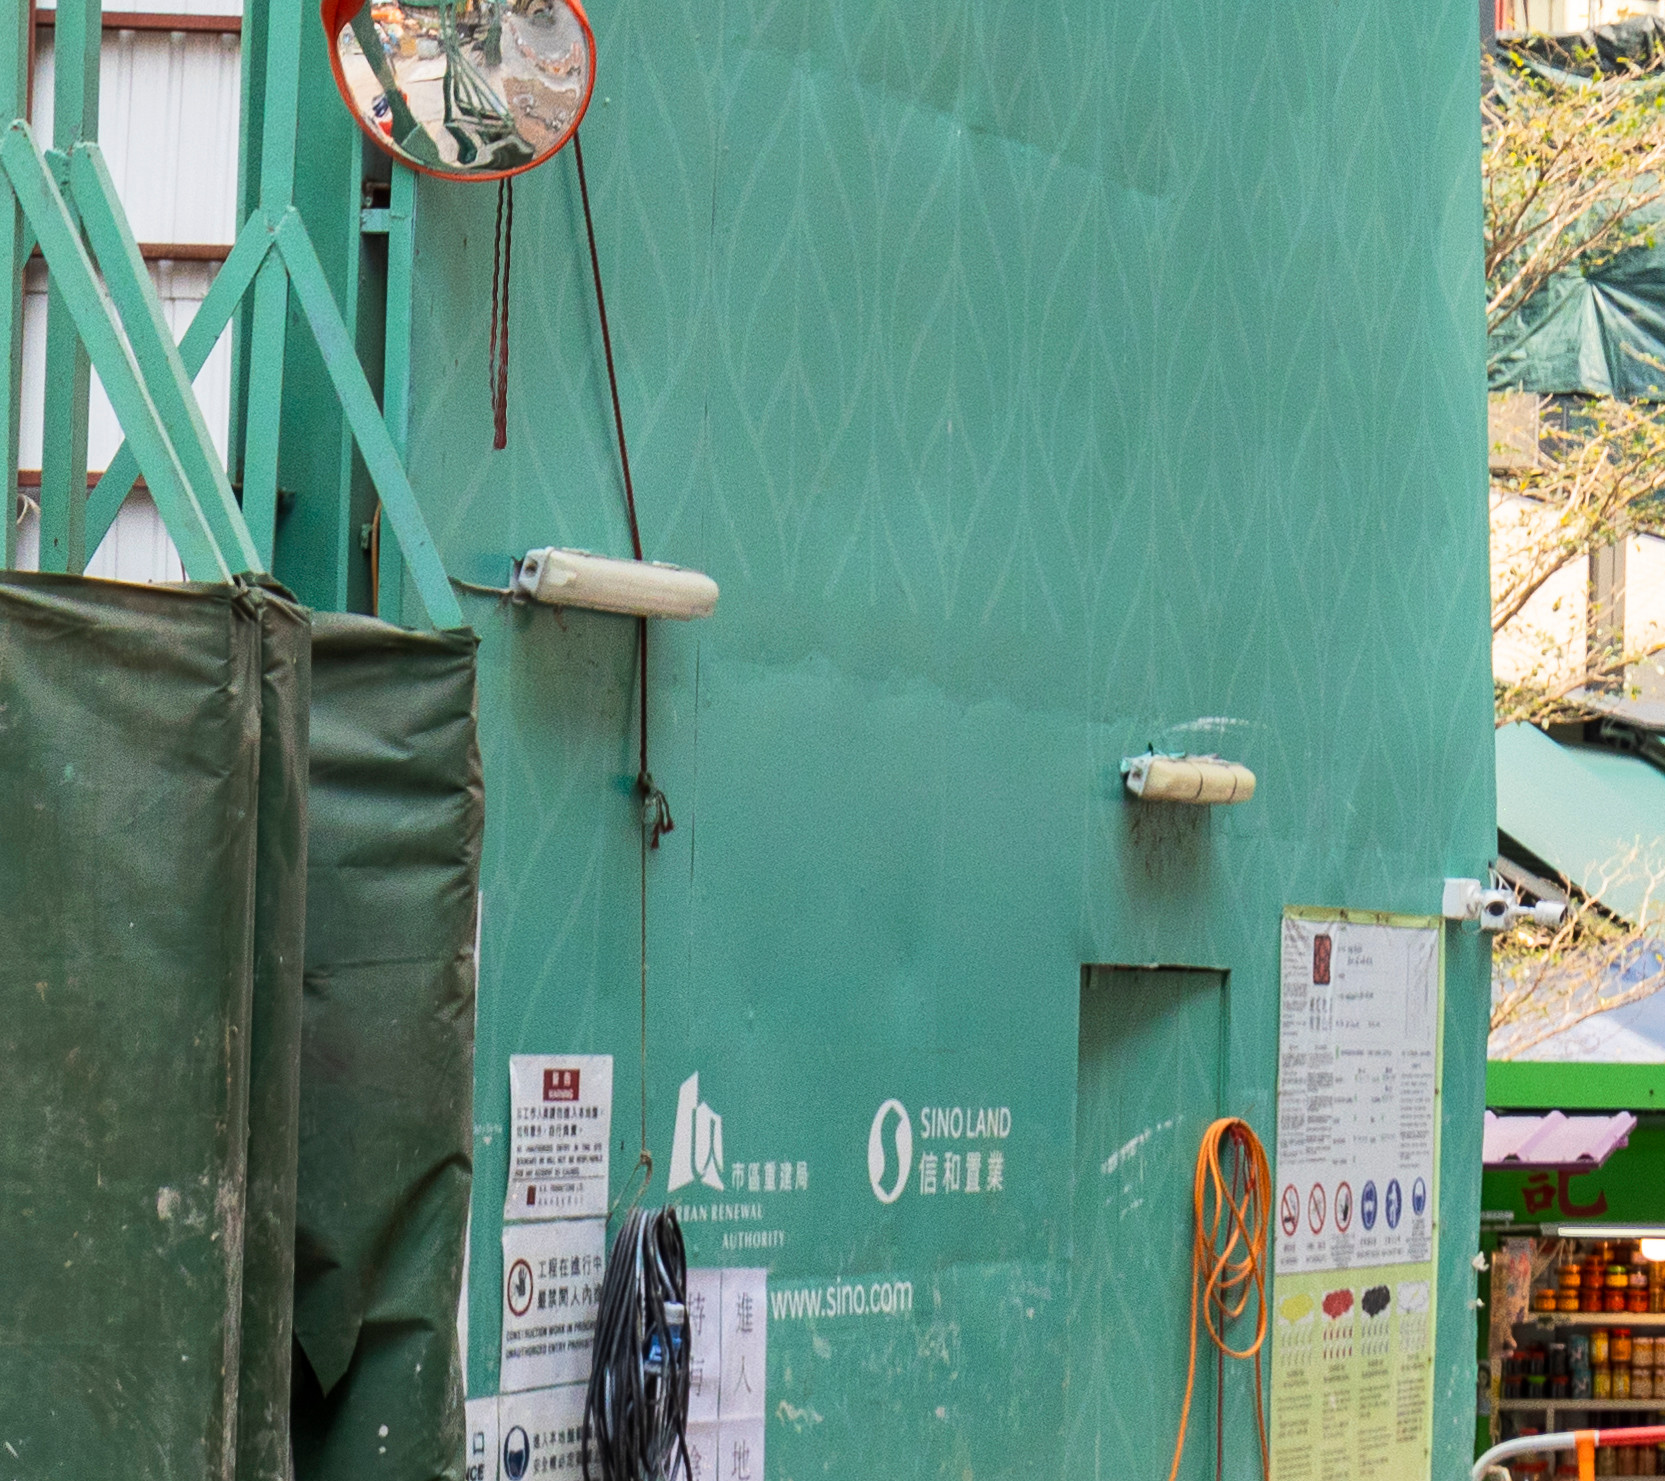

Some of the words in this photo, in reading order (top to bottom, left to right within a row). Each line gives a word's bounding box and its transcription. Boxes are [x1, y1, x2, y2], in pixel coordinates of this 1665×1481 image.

[920, 1107, 963, 1138] SINO
[966, 1107, 1012, 1139] LAND
[731, 1161, 809, 1192] 市區重建局
[919, 1151, 1005, 1196] 信和置業
[673, 1204, 708, 1222] RBAN
[711, 1203, 764, 1221] RENEWAL
[721, 1230, 786, 1250] AUTHORITY
[771, 1276, 914, 1320] www.sino.com
